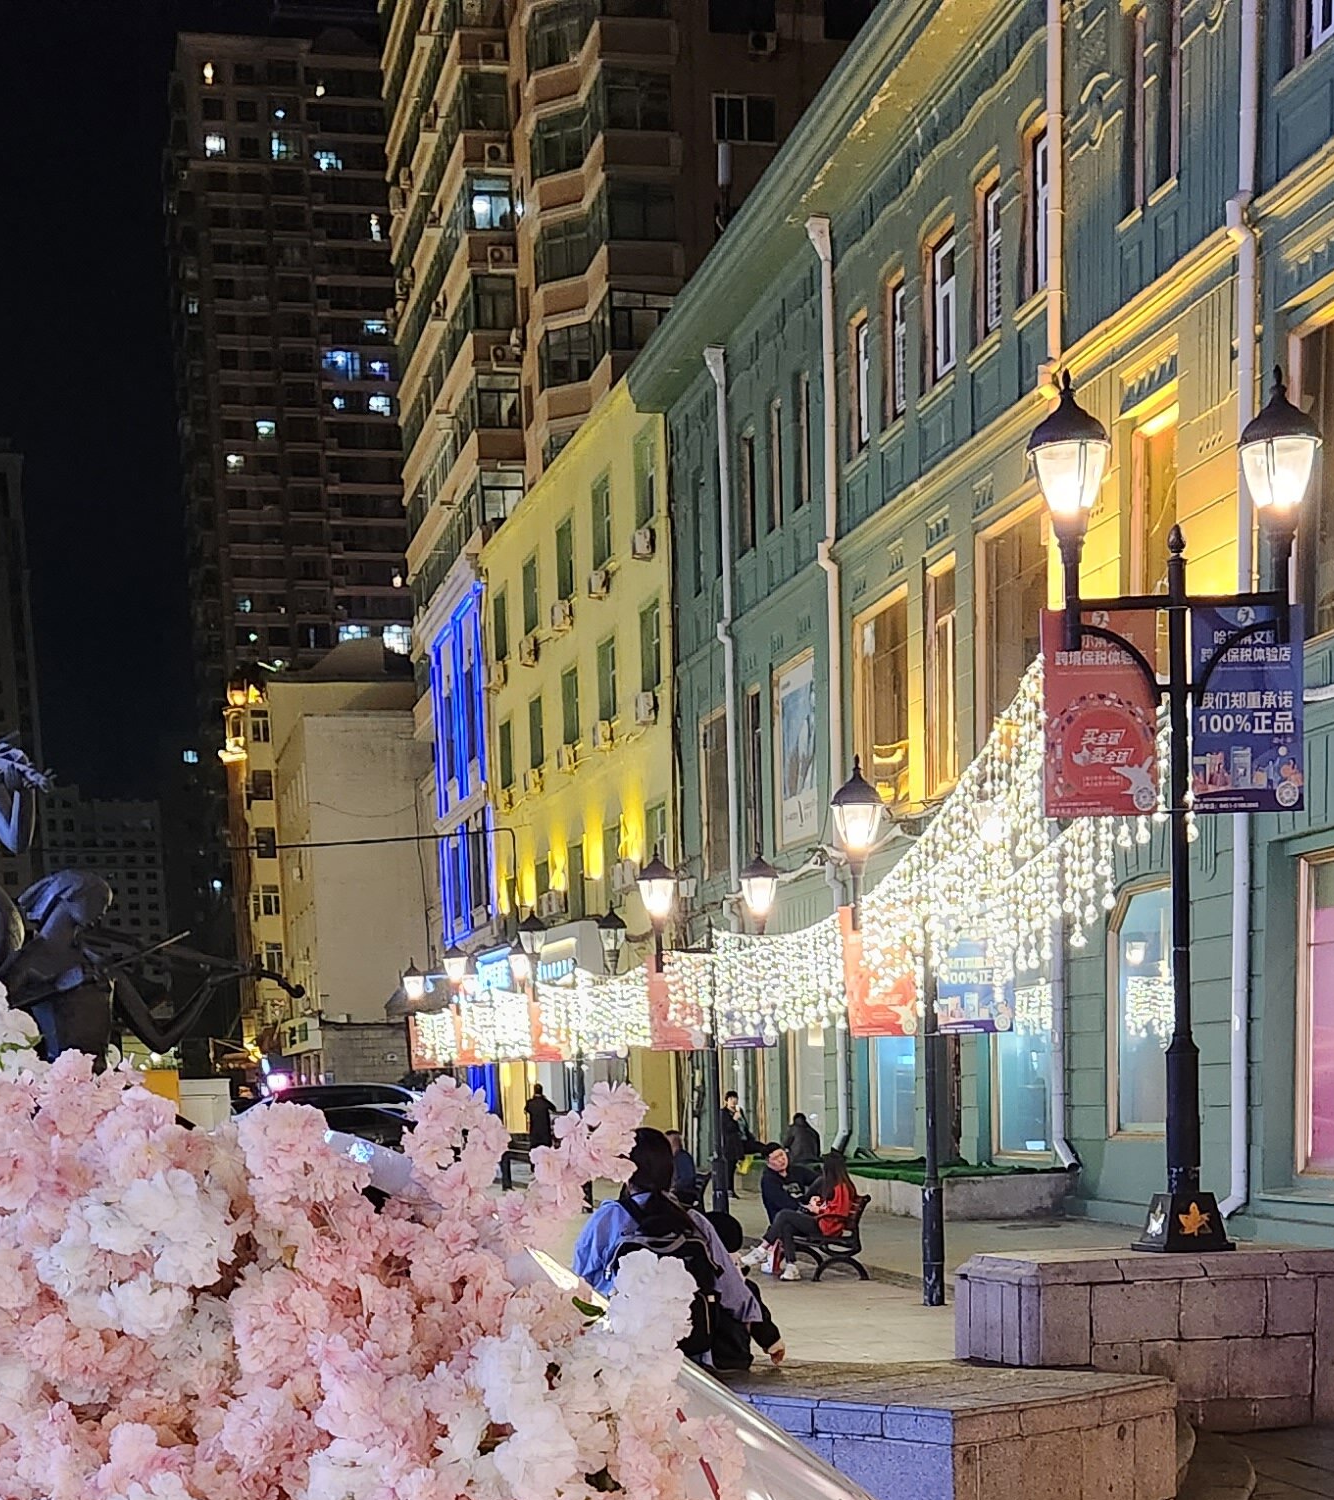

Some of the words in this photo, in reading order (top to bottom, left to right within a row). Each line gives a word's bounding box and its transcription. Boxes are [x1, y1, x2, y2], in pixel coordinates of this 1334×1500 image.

[1055, 650, 1146, 666] 跨境保税体验
[1198, 711, 1295, 735] 100%正品
